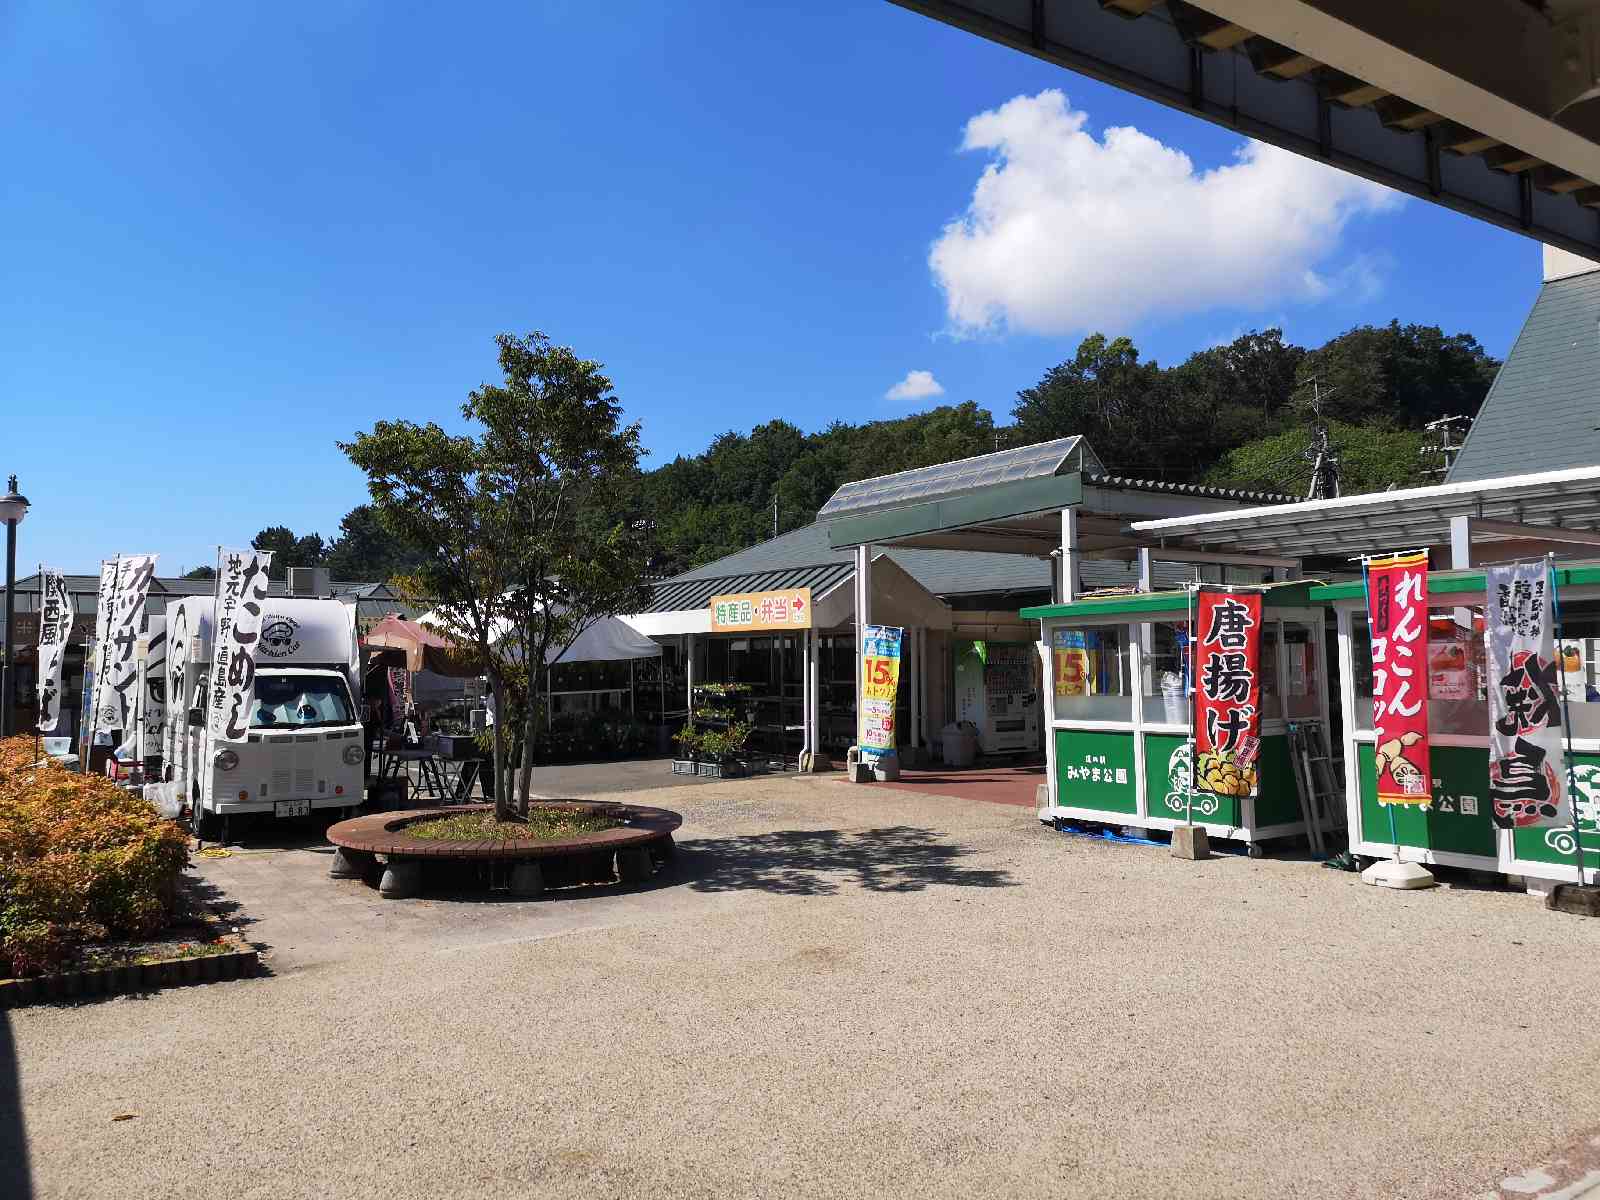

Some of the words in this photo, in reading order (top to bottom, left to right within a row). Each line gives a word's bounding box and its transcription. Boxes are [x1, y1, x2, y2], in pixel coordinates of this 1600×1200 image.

[226, 555, 269, 739] たこめし
[716, 598, 787, 624] 特産品・弁当
[1388, 570, 1424, 717] れんこん
[1204, 599, 1255, 754] 唐揚げ
[1067, 765, 1128, 784] みやま公園
[1430, 796, 1479, 816] 公園
